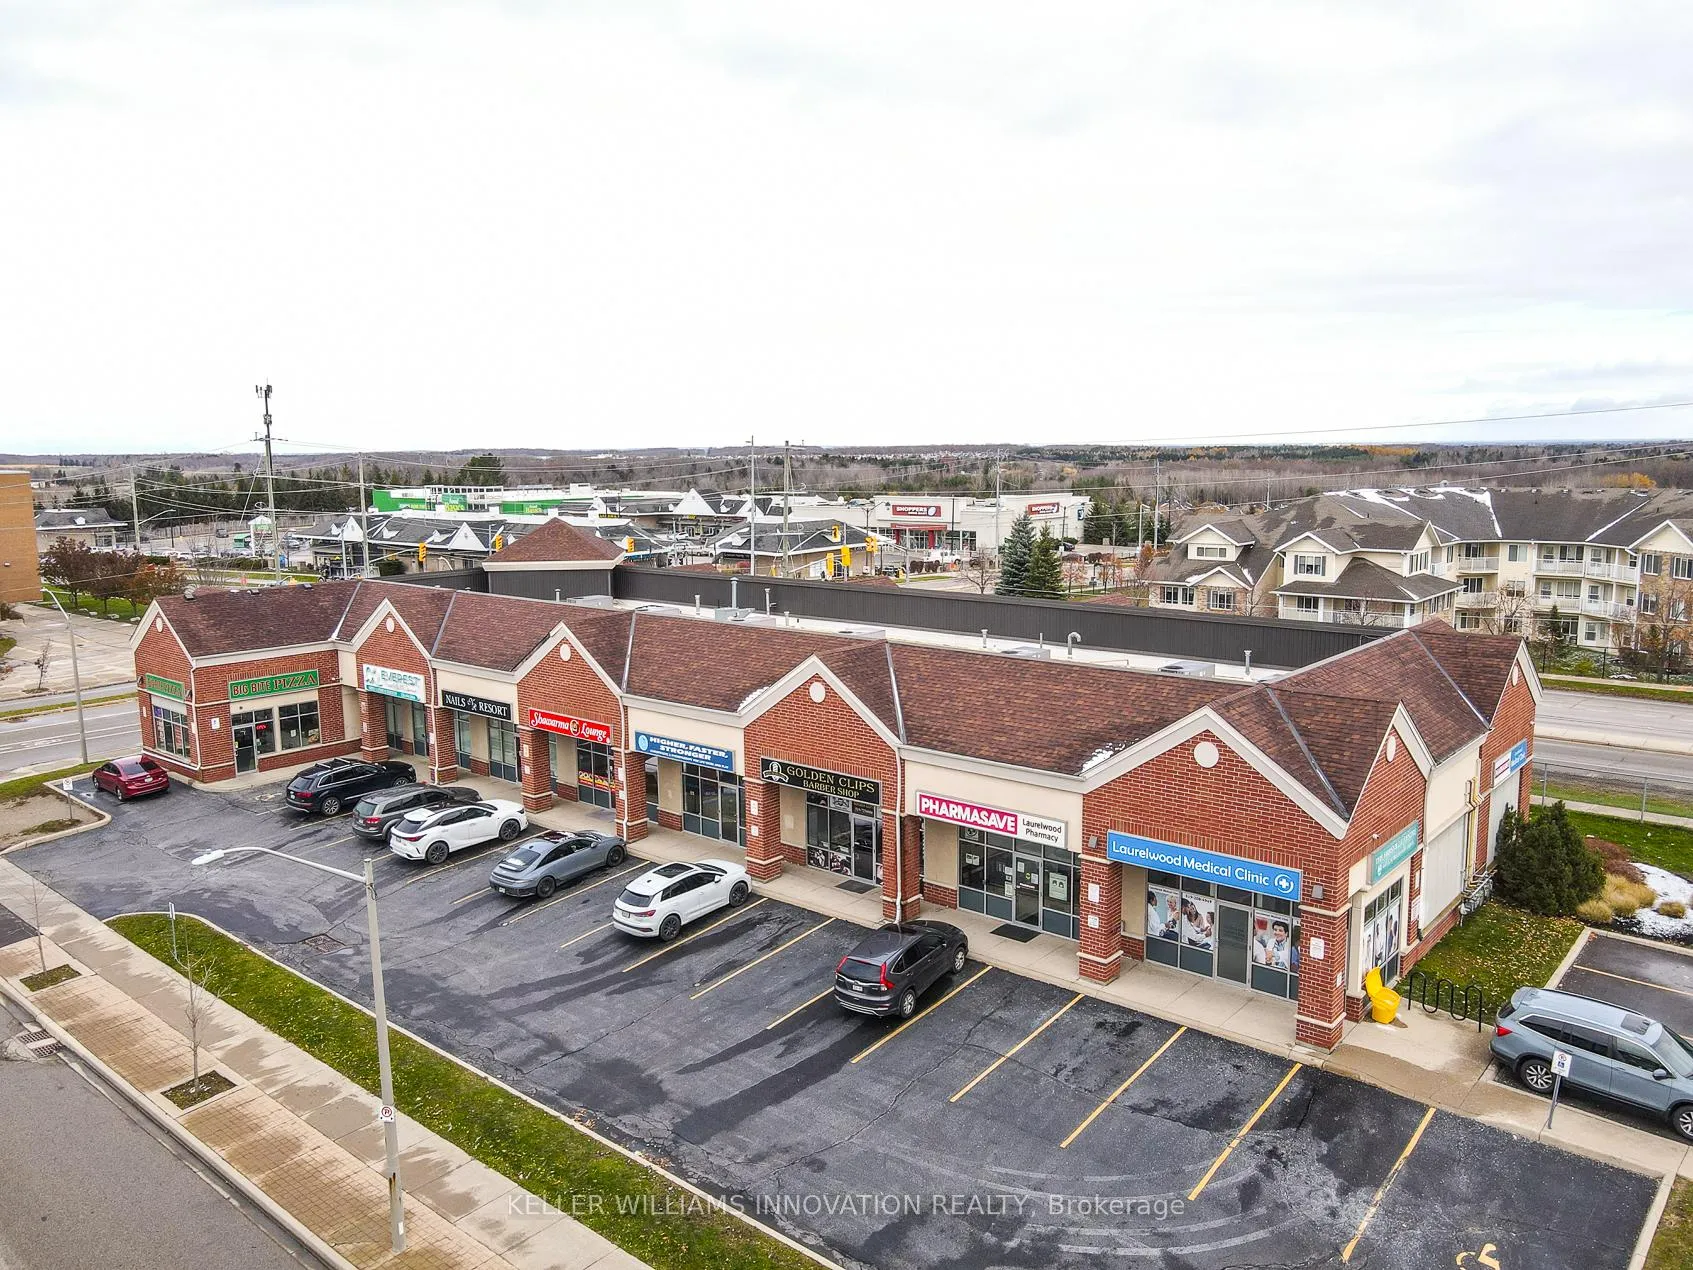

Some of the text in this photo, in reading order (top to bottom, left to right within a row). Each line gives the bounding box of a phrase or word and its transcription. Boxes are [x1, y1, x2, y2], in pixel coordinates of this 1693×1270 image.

[233, 674, 316, 696] BIG BITE PIZZA
[445, 694, 466, 707] NAILS
[478, 701, 508, 717] RESORT
[581, 724, 607, 742] Lounge
[660, 745, 711, 761] STRONGER
[786, 765, 875, 793] GOLDEN CLIPS
[802, 780, 860, 799] BARBER SHOP
[920, 797, 1016, 832] PHARMASAVE
[1022, 818, 1063, 834] Laurelwood
[1025, 828, 1059, 843] Pharmacy
[1112, 841, 1270, 886] Laurelwood Medical Clinic
